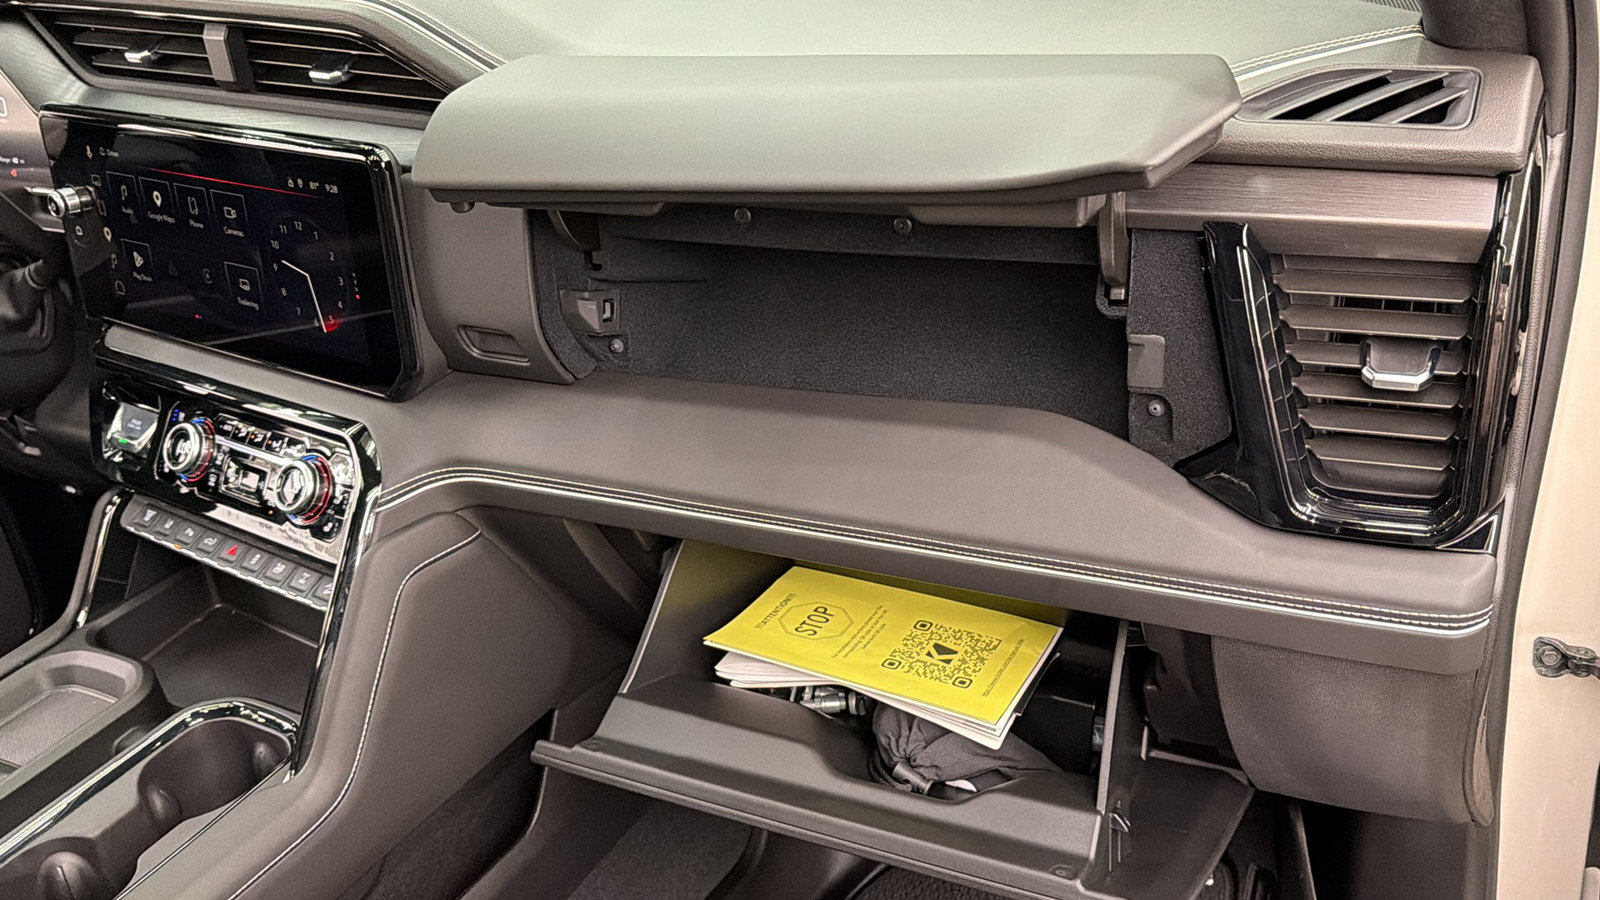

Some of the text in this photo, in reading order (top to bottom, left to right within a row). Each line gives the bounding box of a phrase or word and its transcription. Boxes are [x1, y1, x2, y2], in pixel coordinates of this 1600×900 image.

[279, 225, 288, 234] 11
[294, 221, 303, 231] 12
[270, 240, 280, 250] 10
[329, 252, 335, 261] 2
[273, 263, 278, 271] 9
[338, 276, 344, 286] 3
[281, 287, 287, 296] 8
[338, 301, 343, 309] 4
[296, 307, 301, 315] 7
[329, 315, 335, 324] 5
[794, 605, 835, 637] STOP
